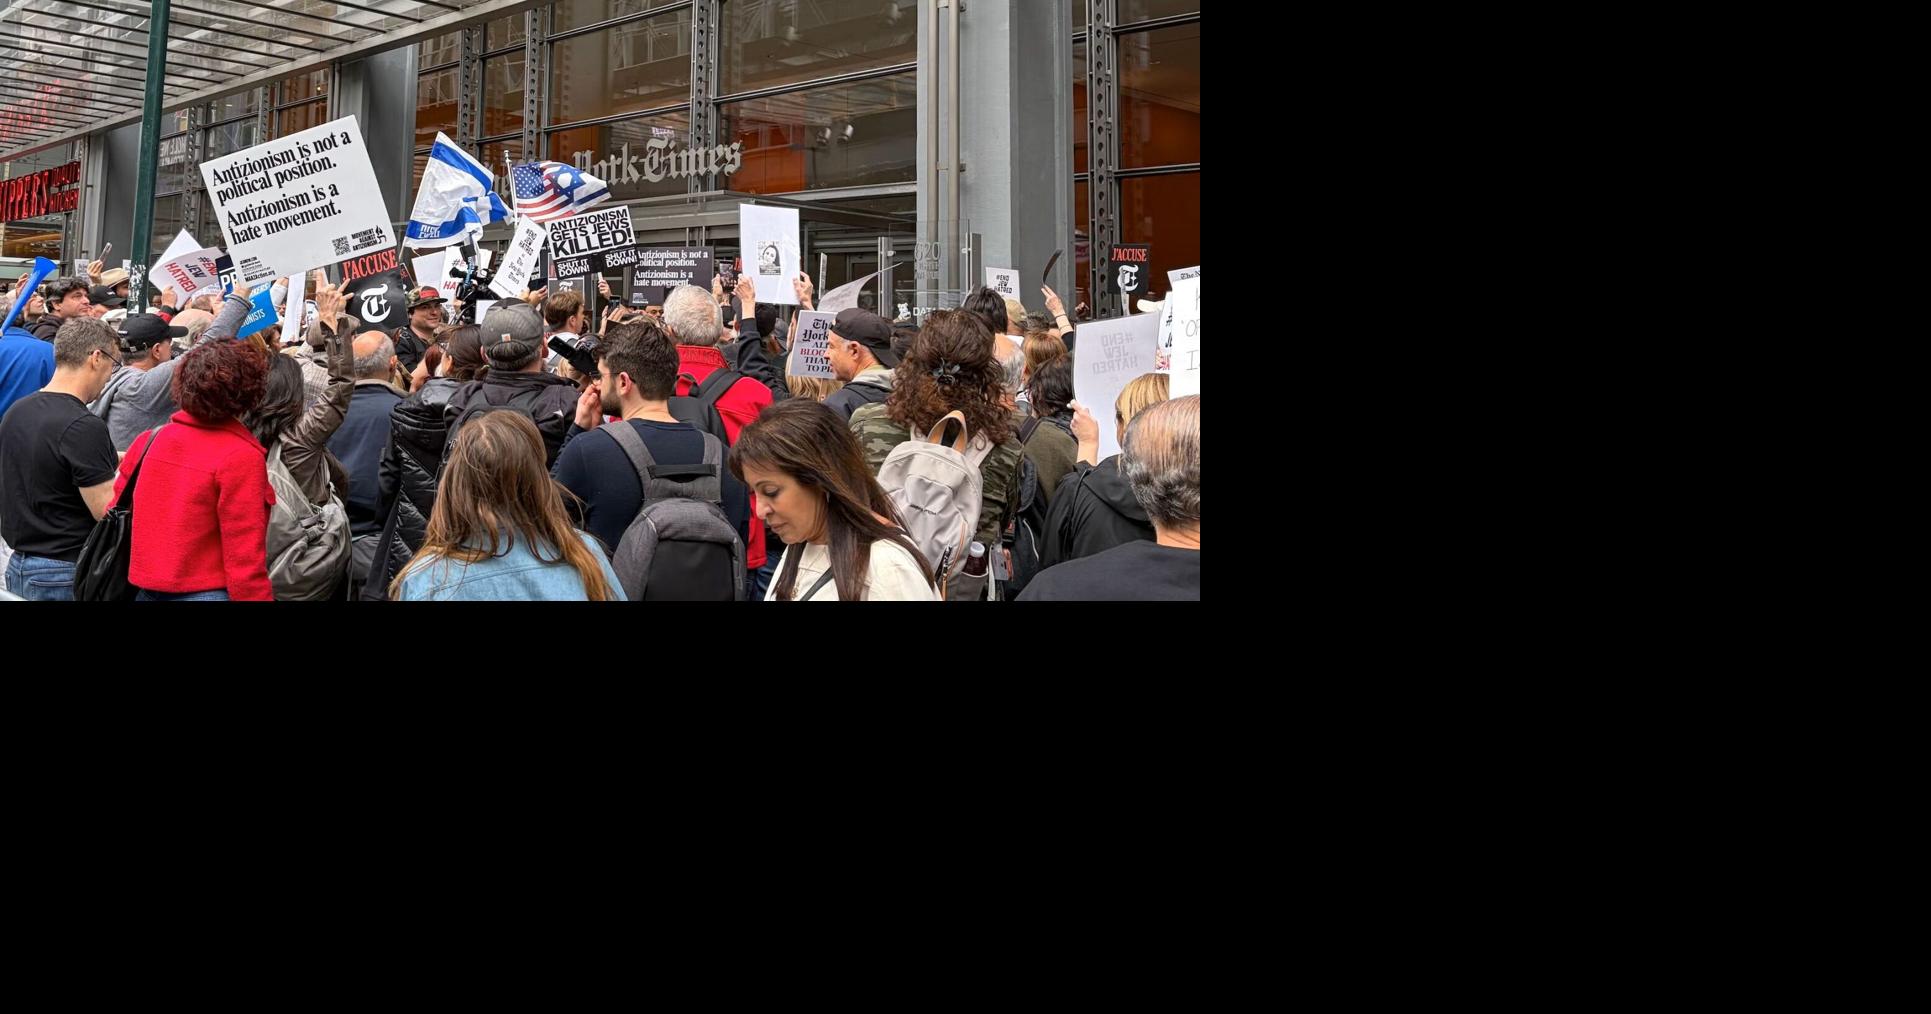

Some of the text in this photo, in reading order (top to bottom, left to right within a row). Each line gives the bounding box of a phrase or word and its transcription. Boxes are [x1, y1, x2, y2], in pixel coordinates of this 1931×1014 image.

[213, 131, 352, 187] Antizionism is not a
[572, 136, 743, 185] York Times
[216, 156, 337, 207] political position.
[227, 183, 340, 229] Antizionism is a
[230, 200, 342, 245] hate movement.
[549, 208, 628, 232] ANTIZIONISM
[551, 217, 630, 243] GETS JEWS
[553, 227, 634, 259] KILLED!
[605, 249, 636, 261] SHUT IT
[606, 254, 638, 268] DOWN!
[681, 250, 688, 259] is
[689, 249, 702, 259] not
[703, 251, 709, 259] a
[1112, 247, 1147, 262] J'ACCUSE
[185, 263, 207, 279] JEW
[342, 249, 398, 282] J'ACCUSE
[557, 260, 580, 271] SHUT
[580, 258, 589, 267] IT
[559, 264, 591, 278] DOWN!
[665, 259, 698, 269] position.
[164, 262, 198, 293] HATRED
[634, 269, 694, 279] Antizionism is a
[634, 277, 650, 287] hate
[812, 318, 829, 330] Th
